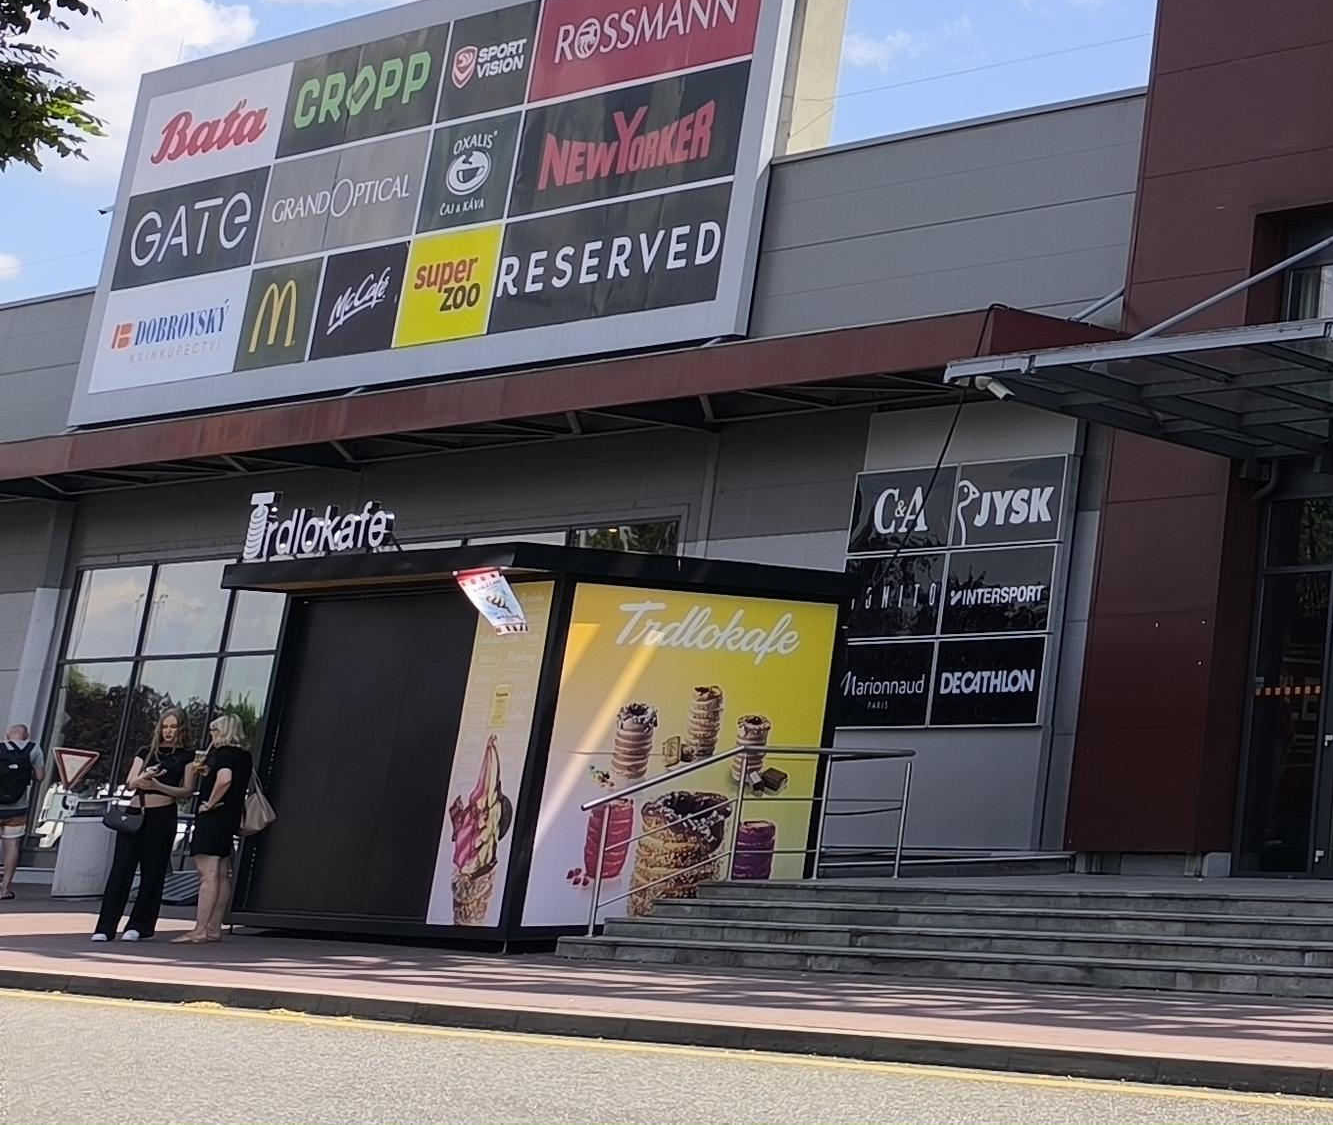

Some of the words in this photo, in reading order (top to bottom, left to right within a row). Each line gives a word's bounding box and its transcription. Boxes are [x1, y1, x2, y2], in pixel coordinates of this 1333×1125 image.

[476, 54, 525, 79] VISION
[477, 38, 528, 63] SPORT
[294, 49, 432, 130] CROPP
[414, 256, 478, 293] super
[495, 220, 722, 298] RESERVED
[134, 298, 230, 346] DOBROVSKÝ
[243, 491, 388, 561] Trdlokafe
[874, 486, 928, 534] C&A
[973, 486, 1055, 527] JYSK
[962, 584, 1047, 606] INTERSPORT
[615, 601, 801, 665] Trdlokafe
[939, 668, 1036, 694] DECATHLON
[867, 701, 889, 709] PARIS
